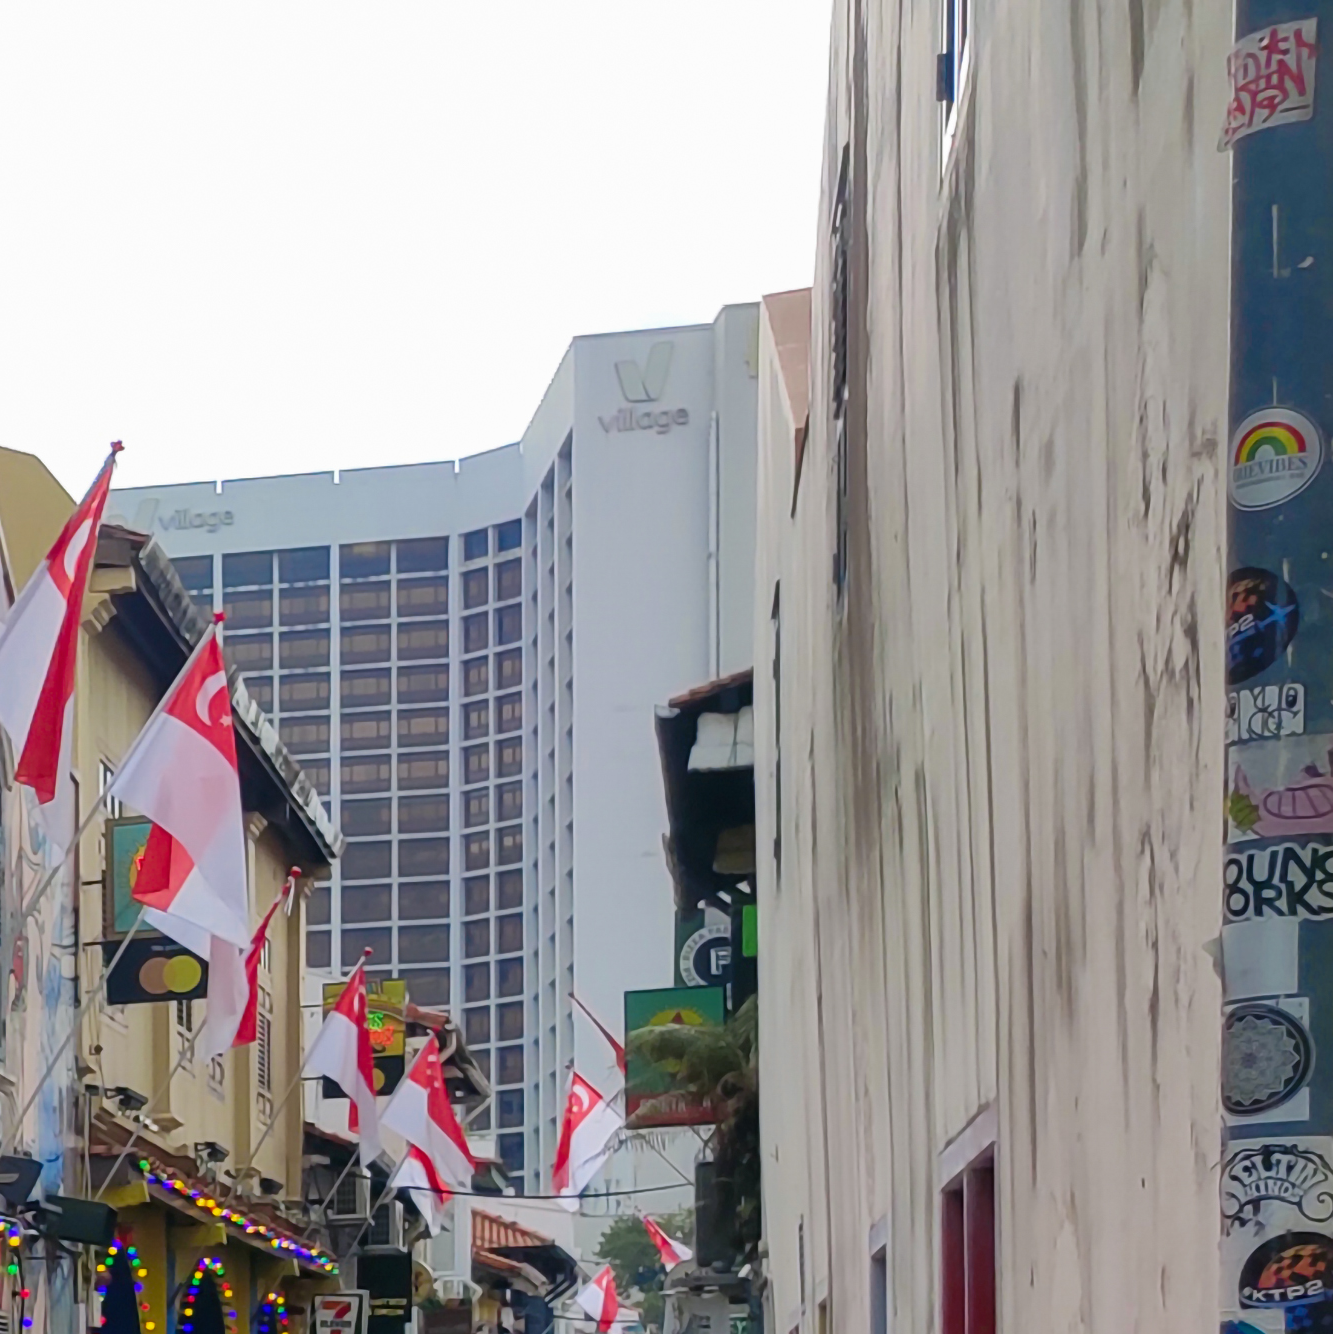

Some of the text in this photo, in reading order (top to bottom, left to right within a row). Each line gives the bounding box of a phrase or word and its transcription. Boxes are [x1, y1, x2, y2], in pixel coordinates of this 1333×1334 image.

[597, 408, 690, 435] village
[158, 508, 234, 533] village
[1252, 1279, 1325, 1302] KTP2
